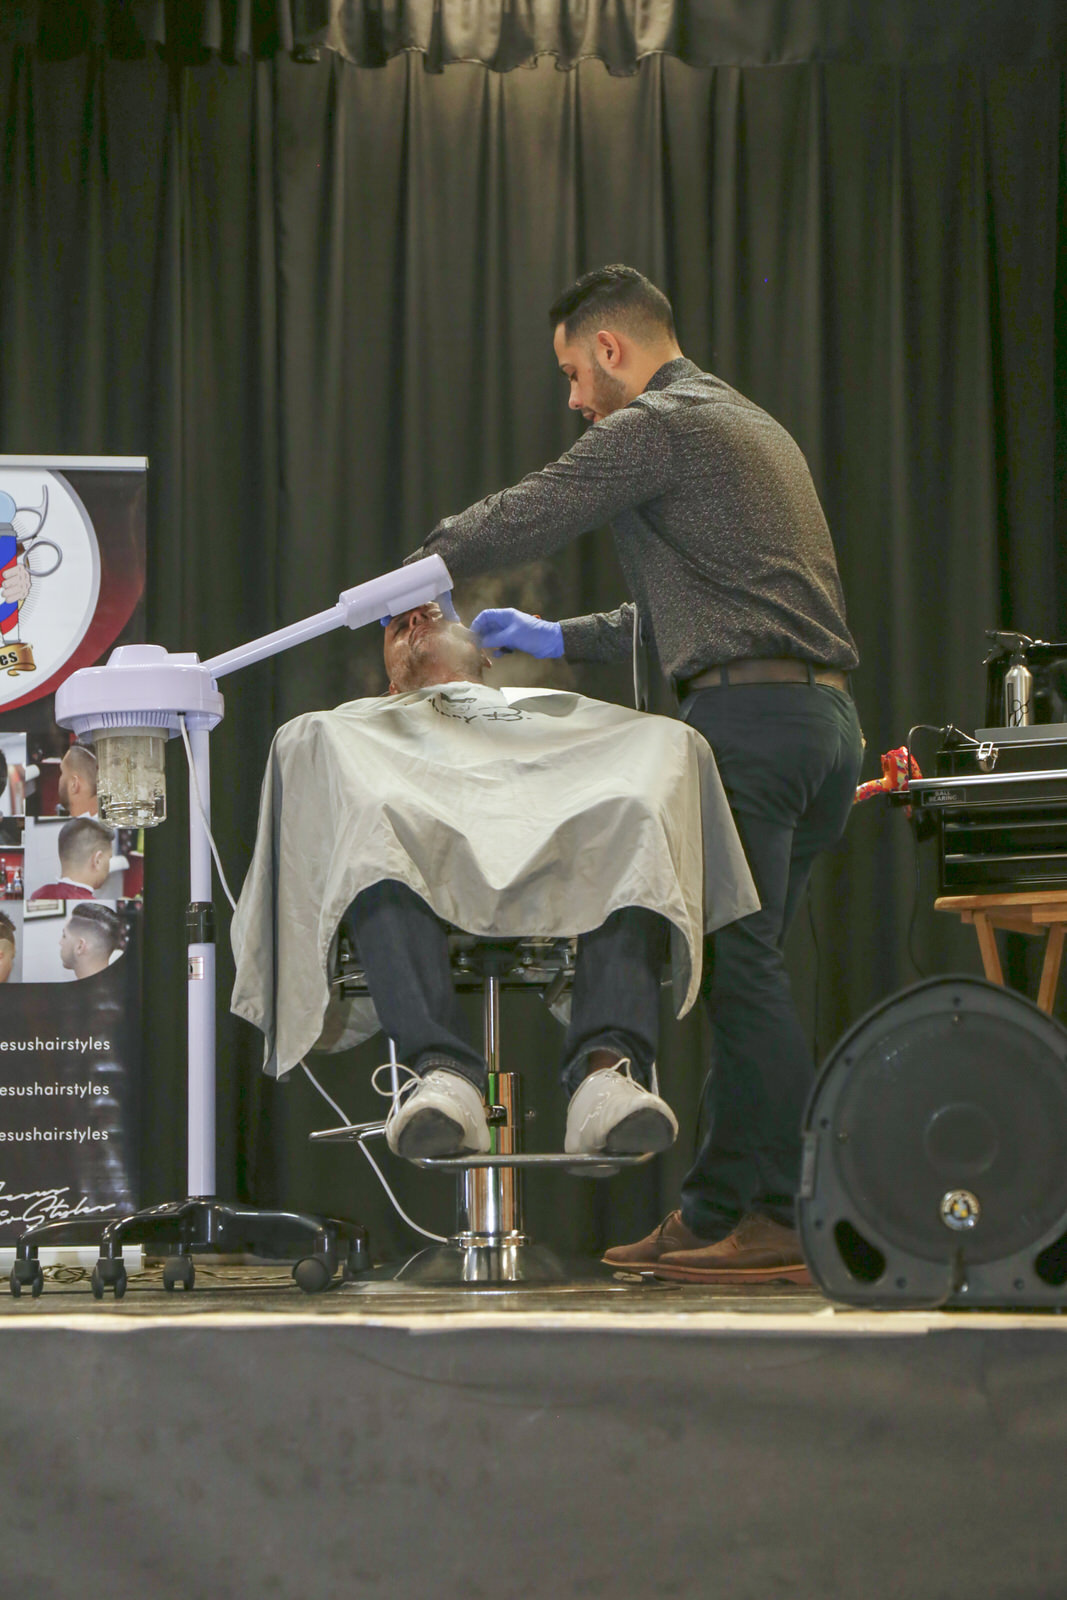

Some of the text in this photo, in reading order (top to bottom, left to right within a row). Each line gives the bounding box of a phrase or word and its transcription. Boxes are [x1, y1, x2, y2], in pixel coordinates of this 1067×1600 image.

[0, 1036, 111, 1054] esushairstyles
[0, 1081, 110, 1099] esushairstyles
[0, 1126, 109, 1144] esushairstyles
